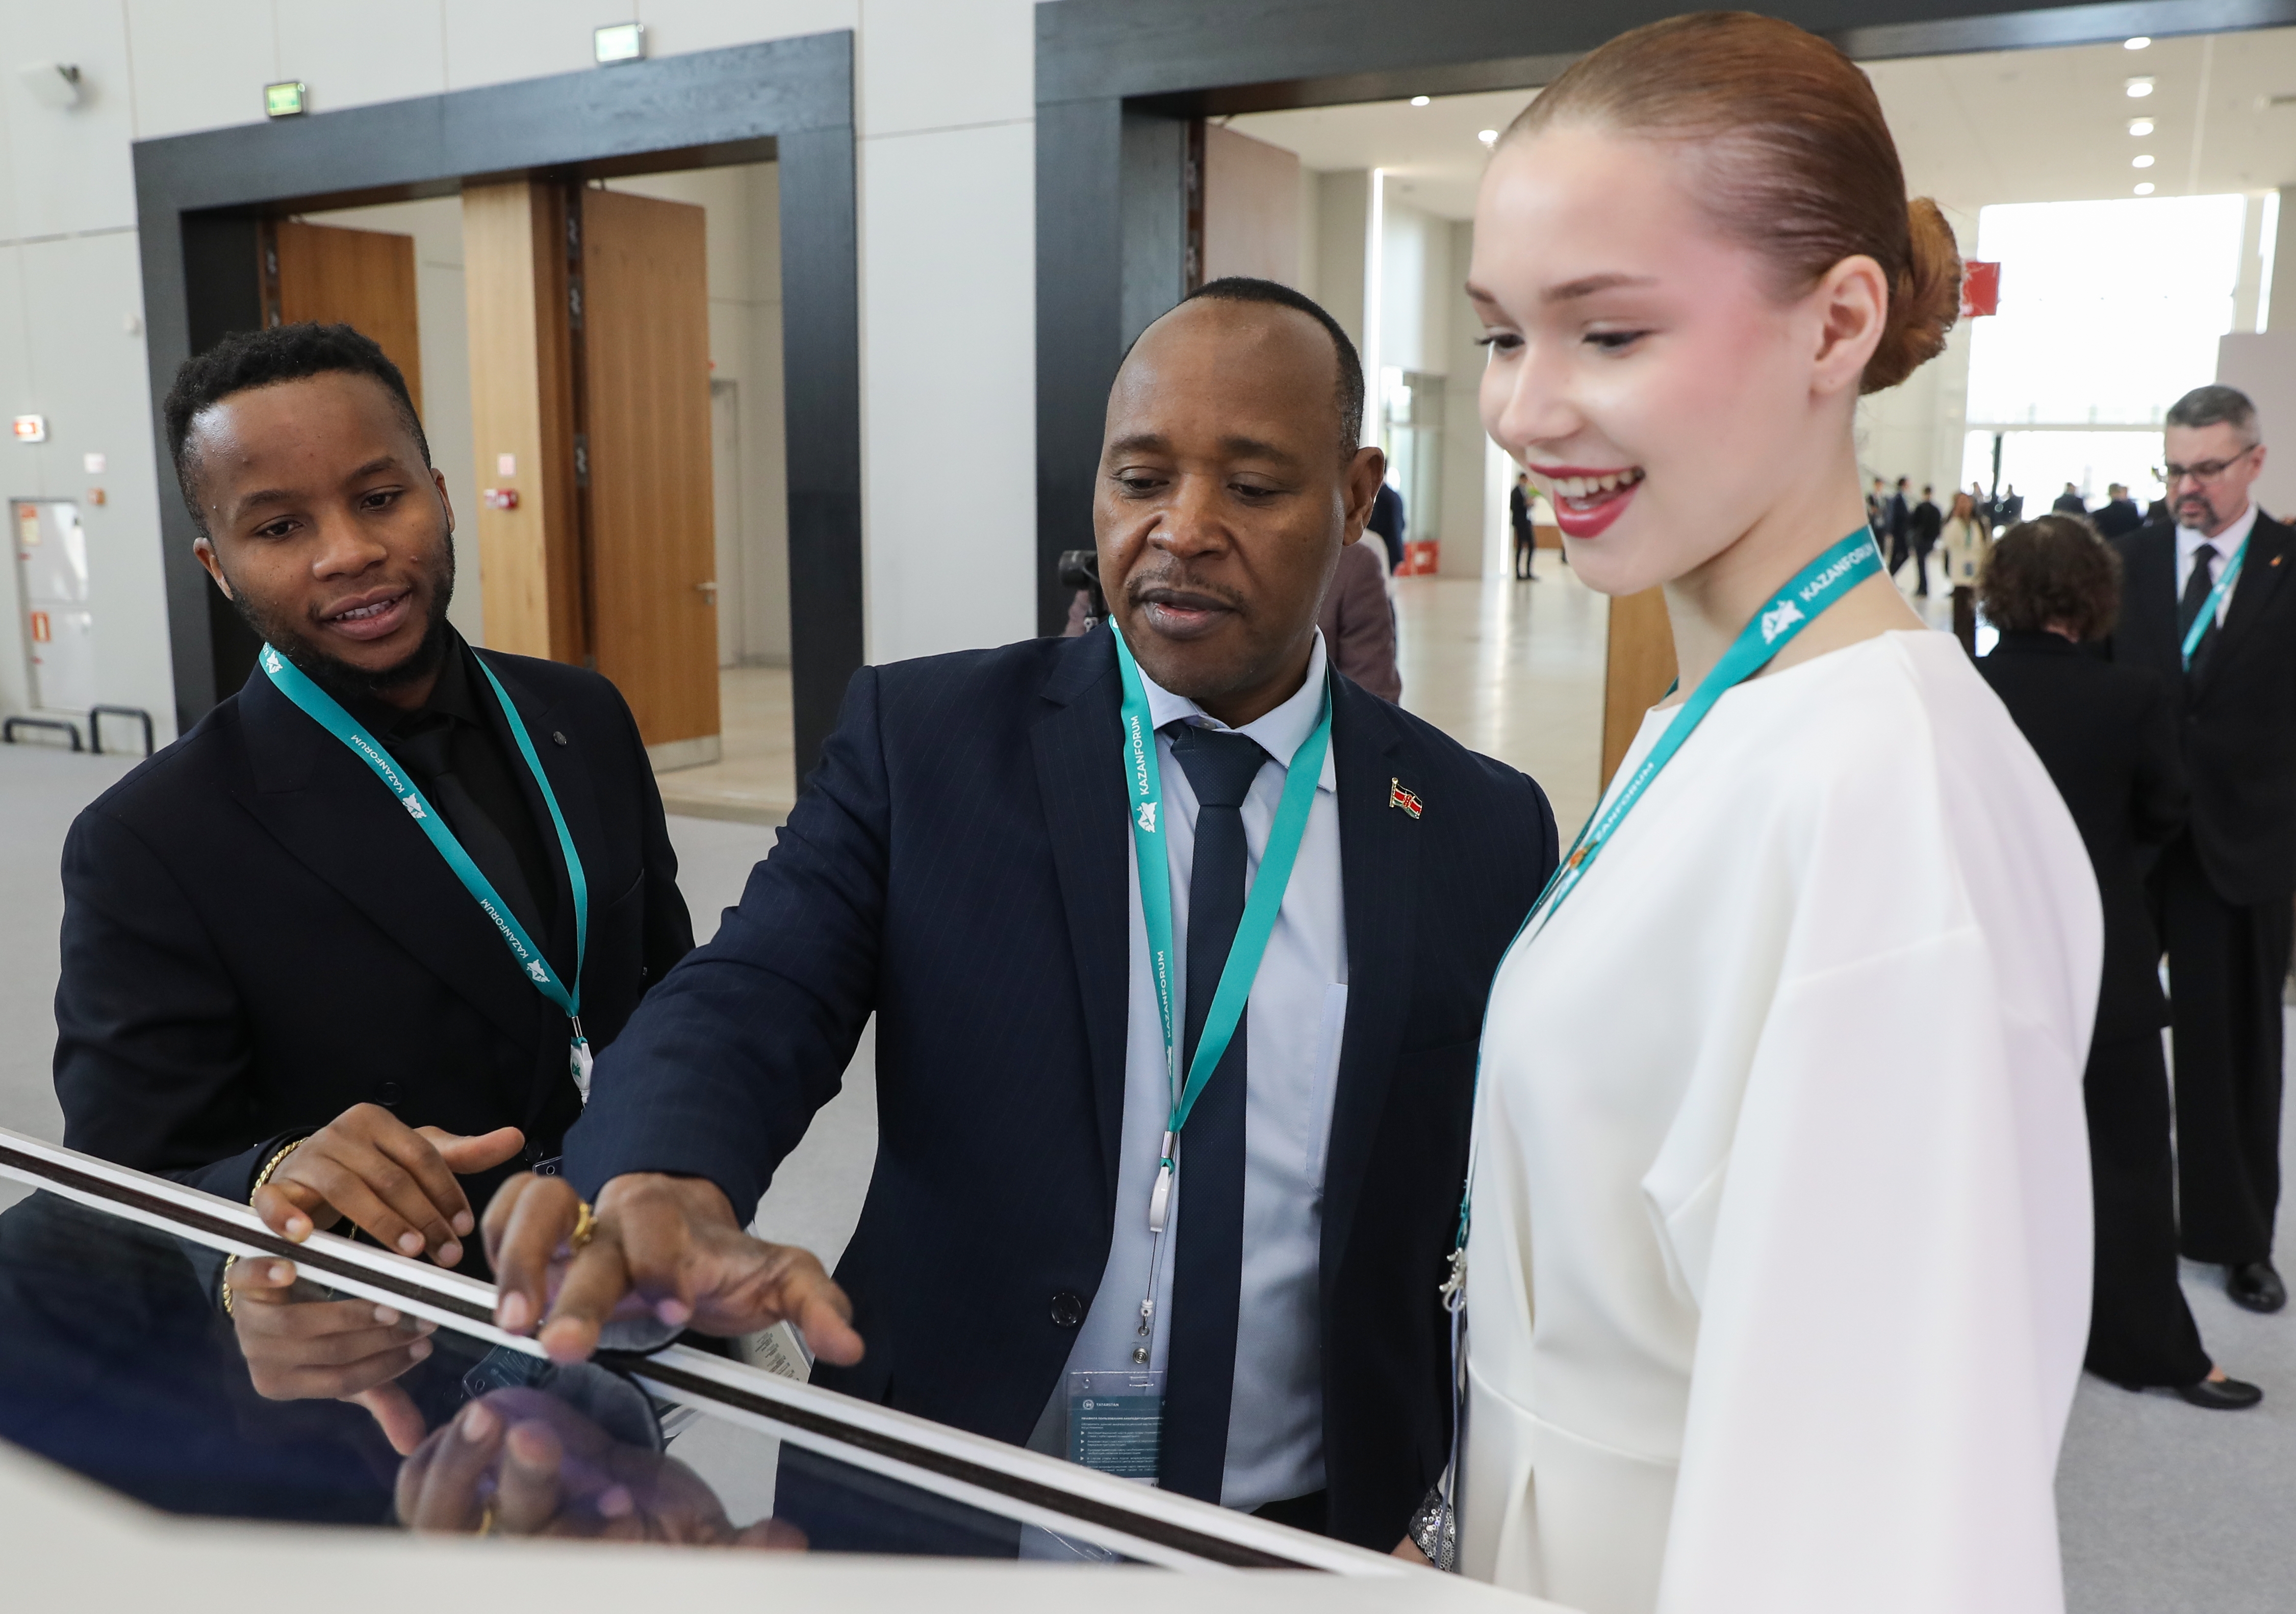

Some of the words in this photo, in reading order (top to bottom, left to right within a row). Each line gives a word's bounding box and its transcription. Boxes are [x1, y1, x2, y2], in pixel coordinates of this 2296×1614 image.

[350, 734, 405, 793] KAZANFORUM
[1130, 715, 1150, 796] KAZANFORUM
[1595, 761, 1654, 841] ZANFORUM
[480, 898, 529, 959] KAZANFORUM
[1157, 950, 1171, 1038] KAZANFORUM
